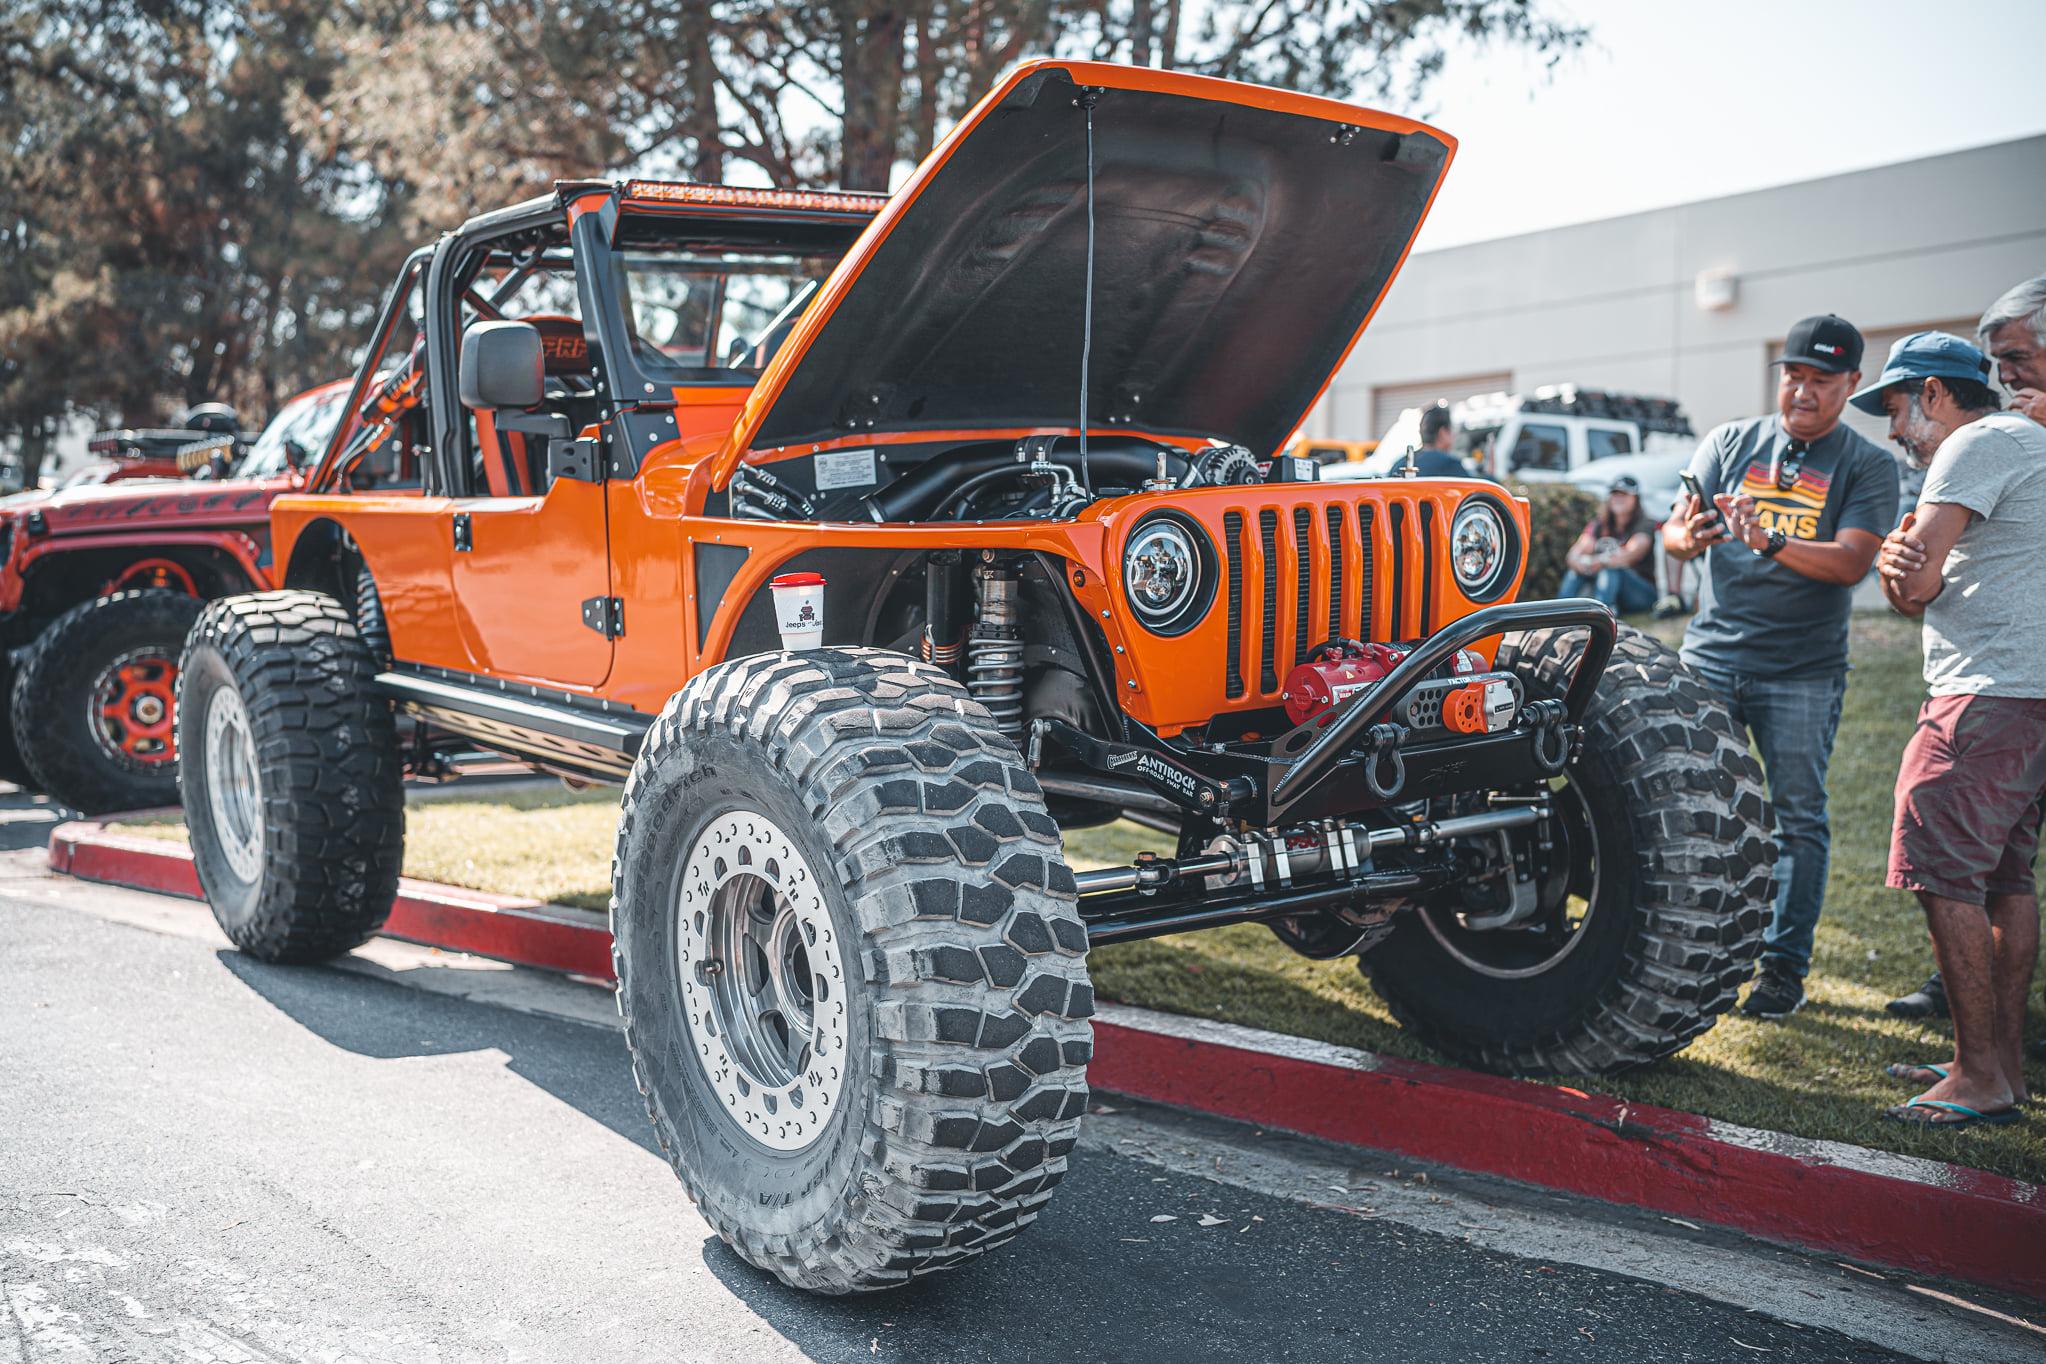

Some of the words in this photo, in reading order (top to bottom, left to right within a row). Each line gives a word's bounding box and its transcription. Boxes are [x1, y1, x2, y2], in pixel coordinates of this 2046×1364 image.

[785, 621, 806, 629] Jeeps
[1137, 765, 1164, 781] OFF-ROAD
[1166, 778, 1181, 790] SWAY
[1182, 788, 1194, 798] BAR
[1138, 754, 1196, 791] ANTIROCK
